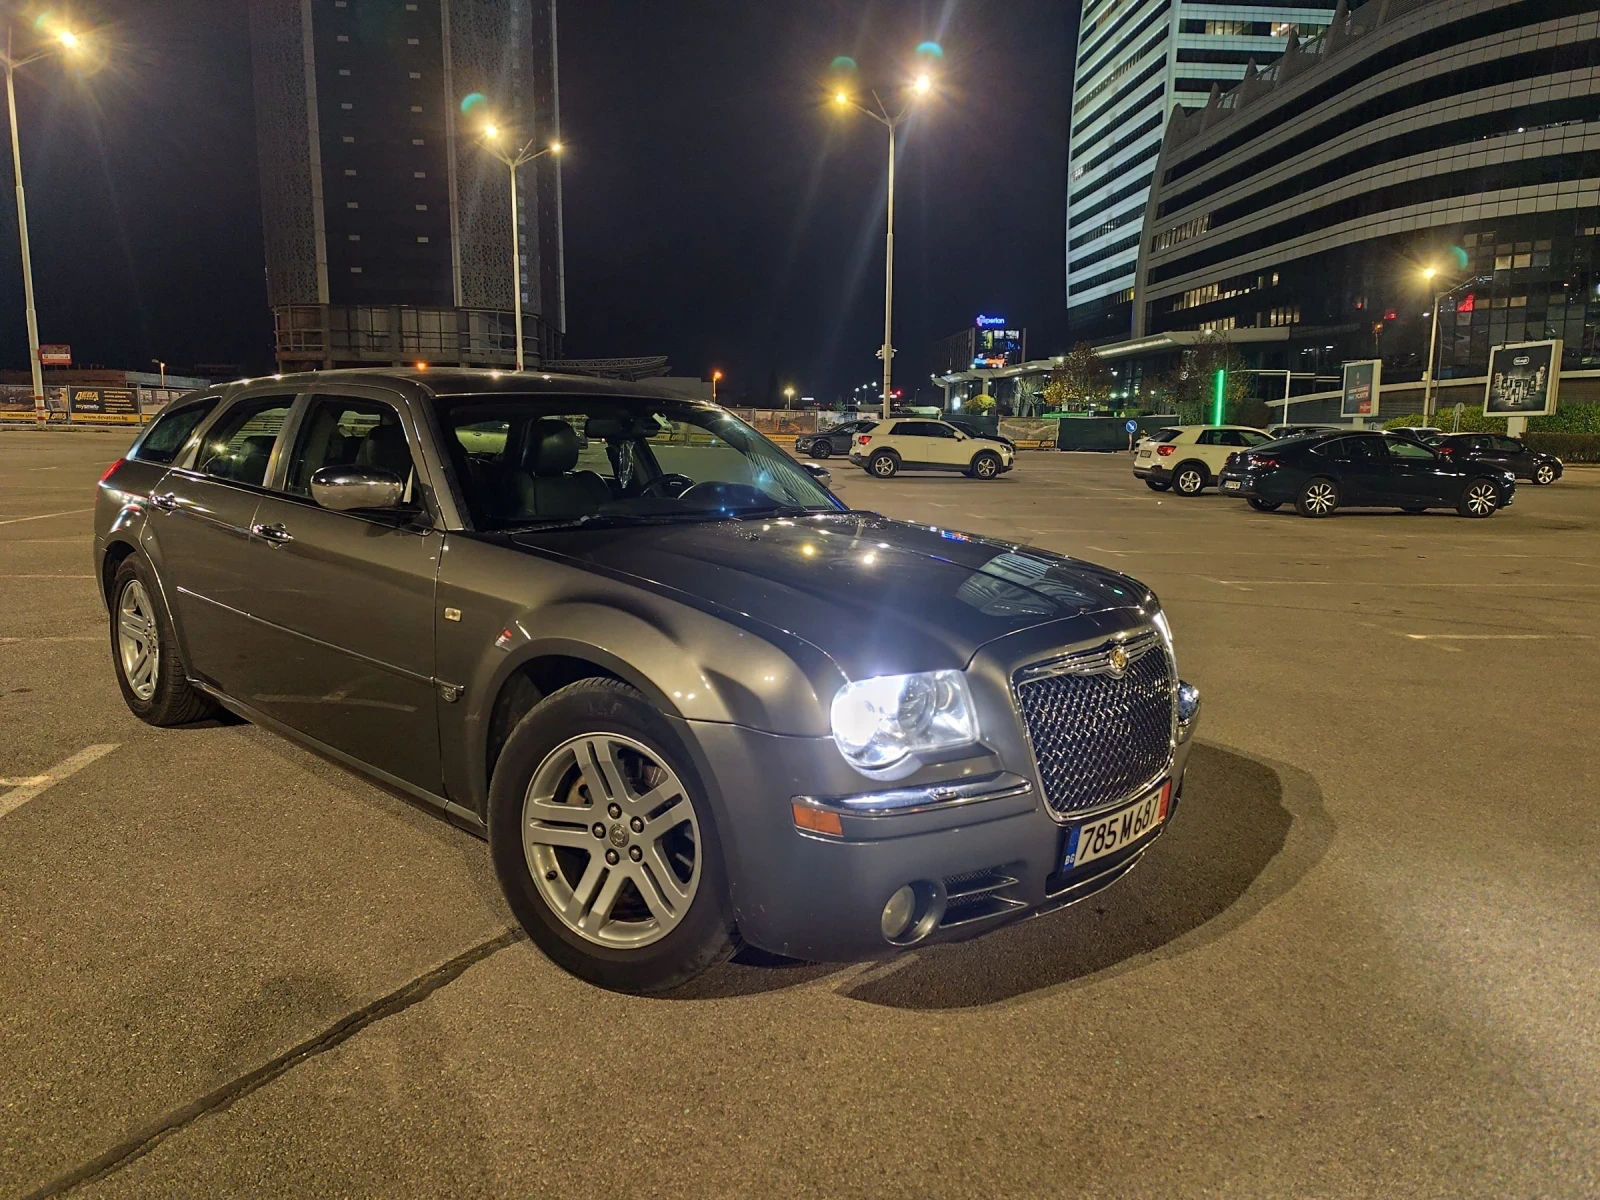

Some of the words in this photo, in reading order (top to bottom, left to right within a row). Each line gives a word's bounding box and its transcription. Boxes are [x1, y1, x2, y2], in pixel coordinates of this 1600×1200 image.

[1079, 817, 1119, 861] 785
[1119, 811, 1134, 845] M
[1134, 793, 1159, 835] 687
[1064, 854, 1075, 865] BG
